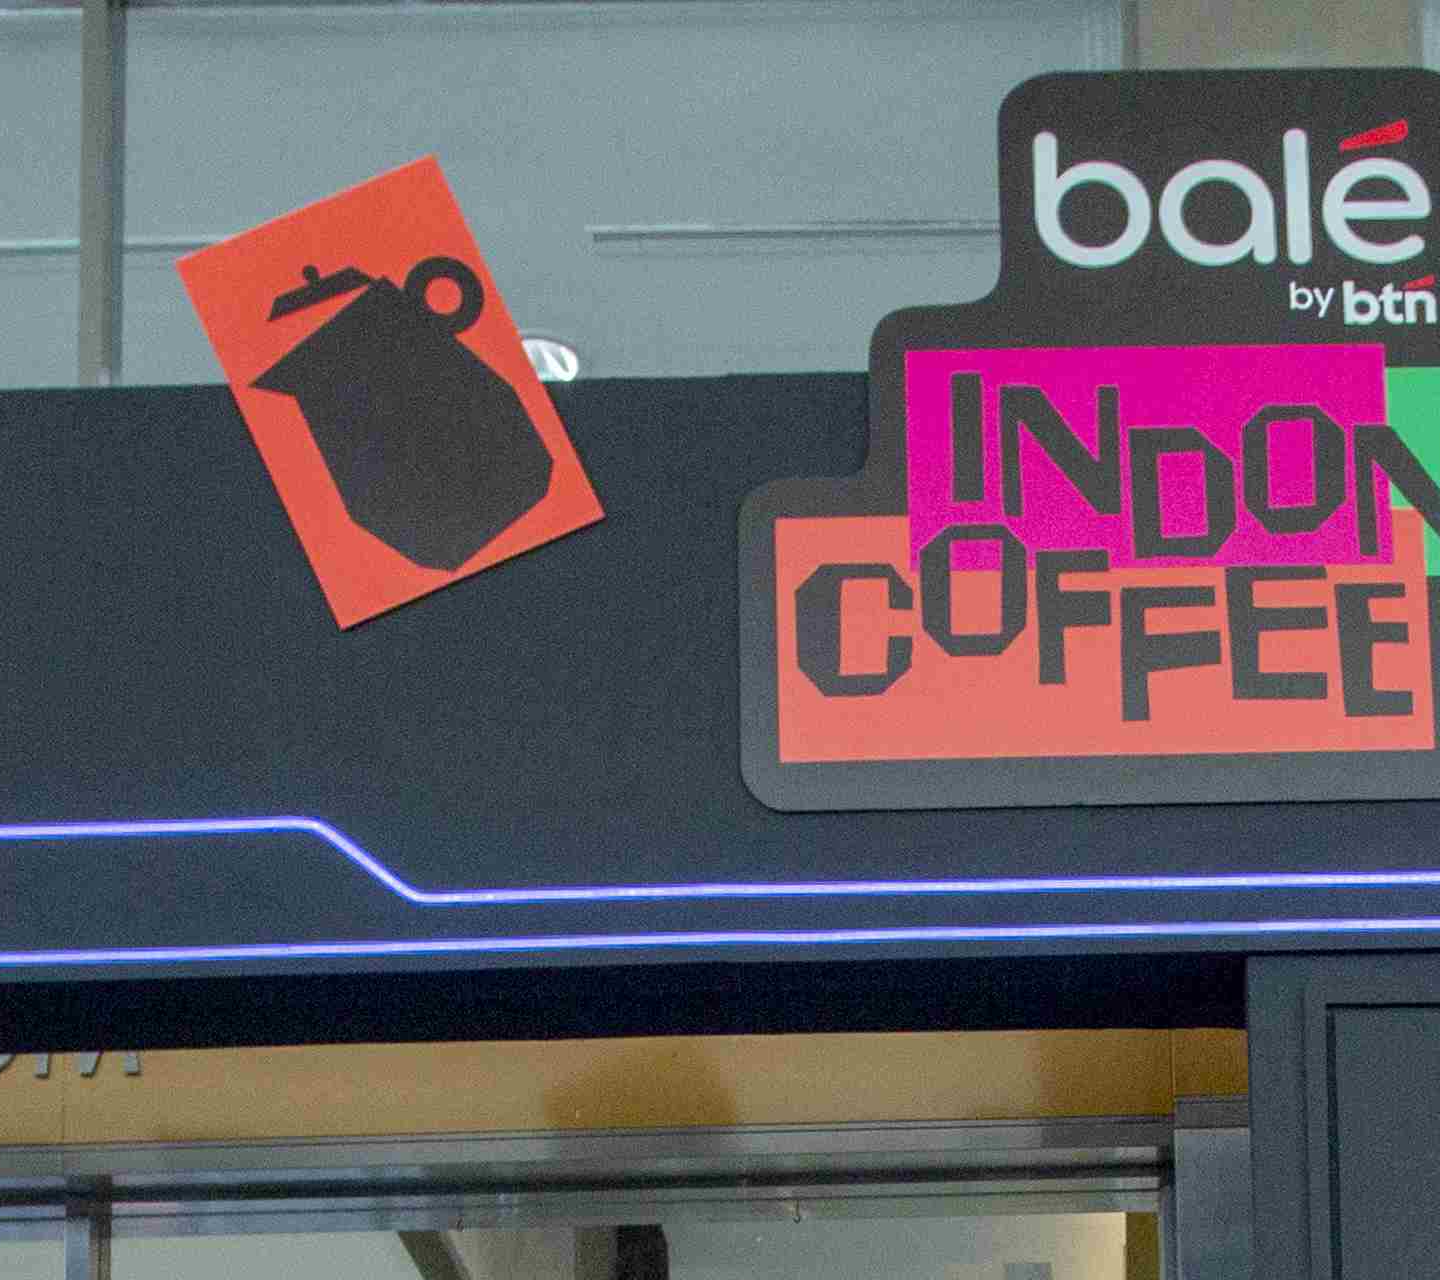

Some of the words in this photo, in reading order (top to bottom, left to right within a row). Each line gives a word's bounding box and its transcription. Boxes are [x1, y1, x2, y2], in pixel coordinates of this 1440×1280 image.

[1033, 117, 1433, 268] balé
[1288, 283, 1336, 317] by
[794, 522, 1413, 722] COFFEE
